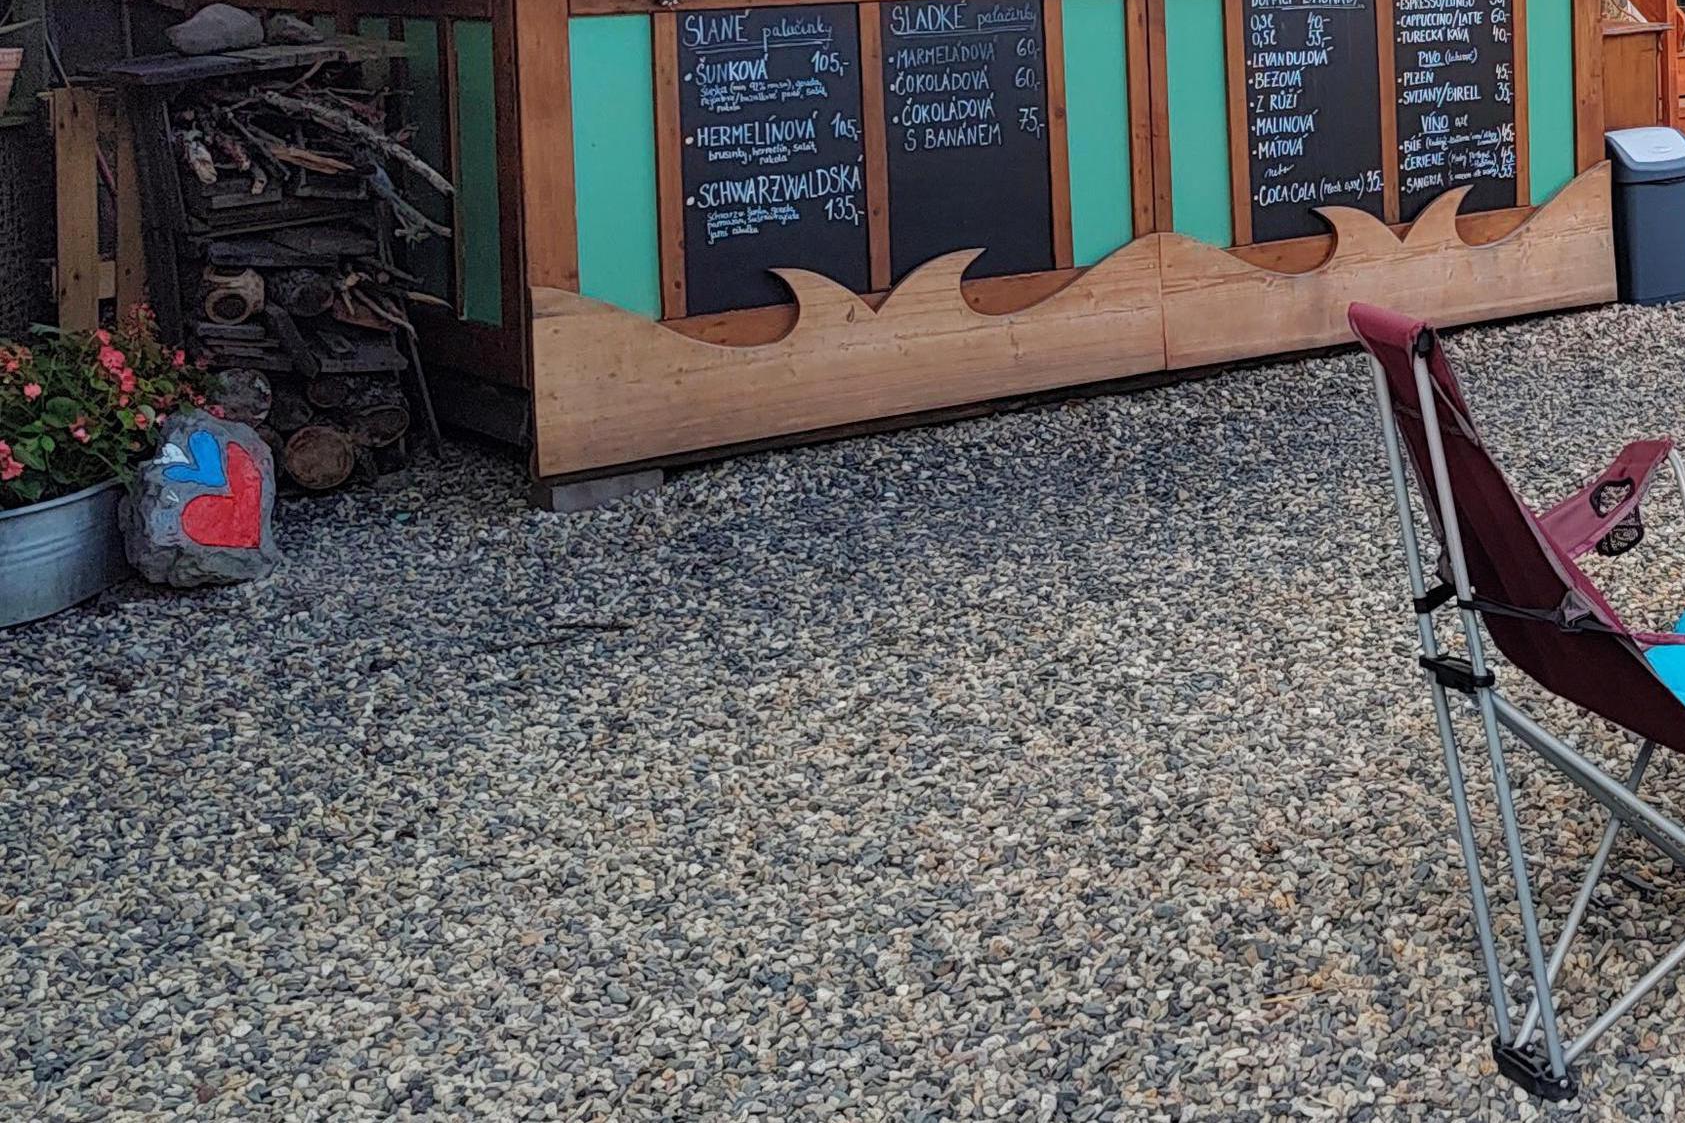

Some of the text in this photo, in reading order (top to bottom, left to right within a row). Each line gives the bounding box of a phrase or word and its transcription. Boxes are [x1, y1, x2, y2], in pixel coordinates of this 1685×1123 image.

[682, 9, 833, 52] SLANÉ palačinky
[1400, 9, 1484, 28] CAPPUCCINO/LATTE
[1400, 26, 1446, 44] TURECKÁ
[1447, 26, 1470, 43] KÁVA
[897, 35, 998, 69] MARMELÁDOVÁ
[1253, 46, 1334, 68] LEVANDULOVÁ
[1418, 49, 1441, 66] PIVO
[696, 53, 769, 86] ŠUNKOVÁ
[896, 65, 989, 95] ČOKOLÁDOVÁ
[902, 92, 995, 126] ČOKOLÁDOVÁ
[1256, 95, 1264, 113] Z
[697, 111, 818, 147] HERMELÍNOVÁ
[1256, 108, 1319, 136] MALINOVÁ
[1421, 111, 1450, 132] VÍNO
[904, 122, 1002, 151] S BANÁNEM
[1258, 132, 1309, 160] MÁTOVÁ
[697, 154, 864, 209] SCHWARZWALDSKÁ
